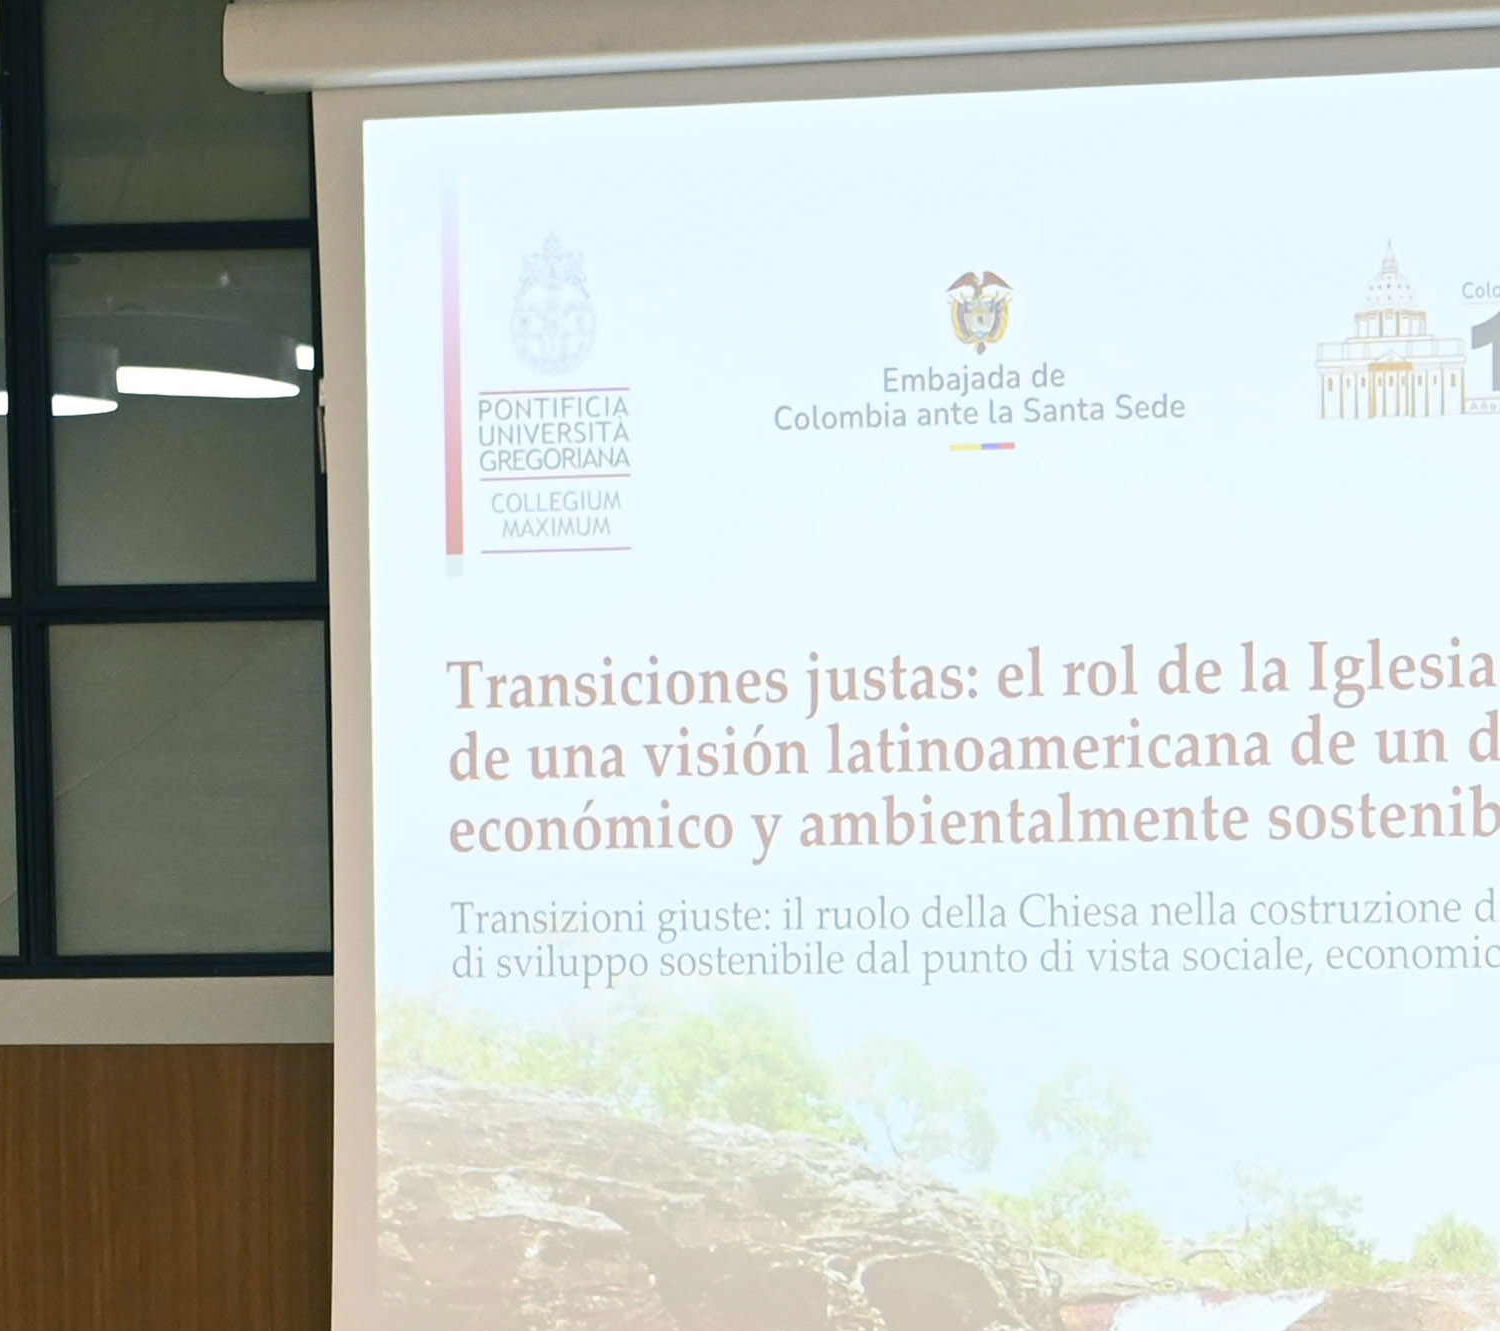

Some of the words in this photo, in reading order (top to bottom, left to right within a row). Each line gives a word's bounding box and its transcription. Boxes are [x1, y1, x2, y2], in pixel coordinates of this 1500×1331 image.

[884, 364, 1020, 397] Embajada
[1032, 362, 1065, 388] de
[479, 396, 628, 421] PONTIFICIA
[775, 402, 906, 430] Colombia
[917, 402, 978, 426] ante
[989, 399, 1012, 424] la
[1024, 397, 1104, 423] Santa
[1116, 393, 1185, 419] Sede
[479, 420, 629, 446] UNIVERSITÀ
[479, 446, 630, 471] GREGORIANA
[492, 490, 621, 513] COLLEGIUM
[502, 516, 611, 538] MAXIMUM
[446, 655, 788, 708] Transiciones
[805, 651, 977, 720] justas:
[998, 646, 1044, 698] el
[1063, 643, 1138, 696] rol
[1158, 642, 1221, 695] de
[1240, 640, 1289, 692] la
[1308, 636, 1496, 708] Iglesia
[450, 730, 509, 781] de
[527, 744, 625, 779] una
[643, 724, 809, 777] visión
[827, 718, 1271, 774] latinoamericana
[1291, 713, 1355, 766] de
[1374, 729, 1448, 764] un
[450, 799, 733, 852] económico
[750, 815, 782, 865] y
[800, 792, 1249, 847] ambientalmente
[451, 900, 644, 934] Transizioni
[658, 900, 770, 944] giuste:
[784, 896, 803, 930] il
[817, 895, 909, 930] ruolo
[922, 894, 1006, 928] della
[1019, 893, 1138, 928] Chiesa
[1151, 891, 1235, 926] nella
[1250, 891, 1461, 925] costruzione
[453, 945, 484, 978] di
[497, 944, 648, 989] sviluppo
[660, 941, 844, 976] sostenibile
[857, 940, 910, 974] dal
[922, 944, 1027, 986] punto
[1040, 938, 1074, 972] di
[1087, 939, 1170, 972] vista
[1183, 936, 1312, 975] sociale,
